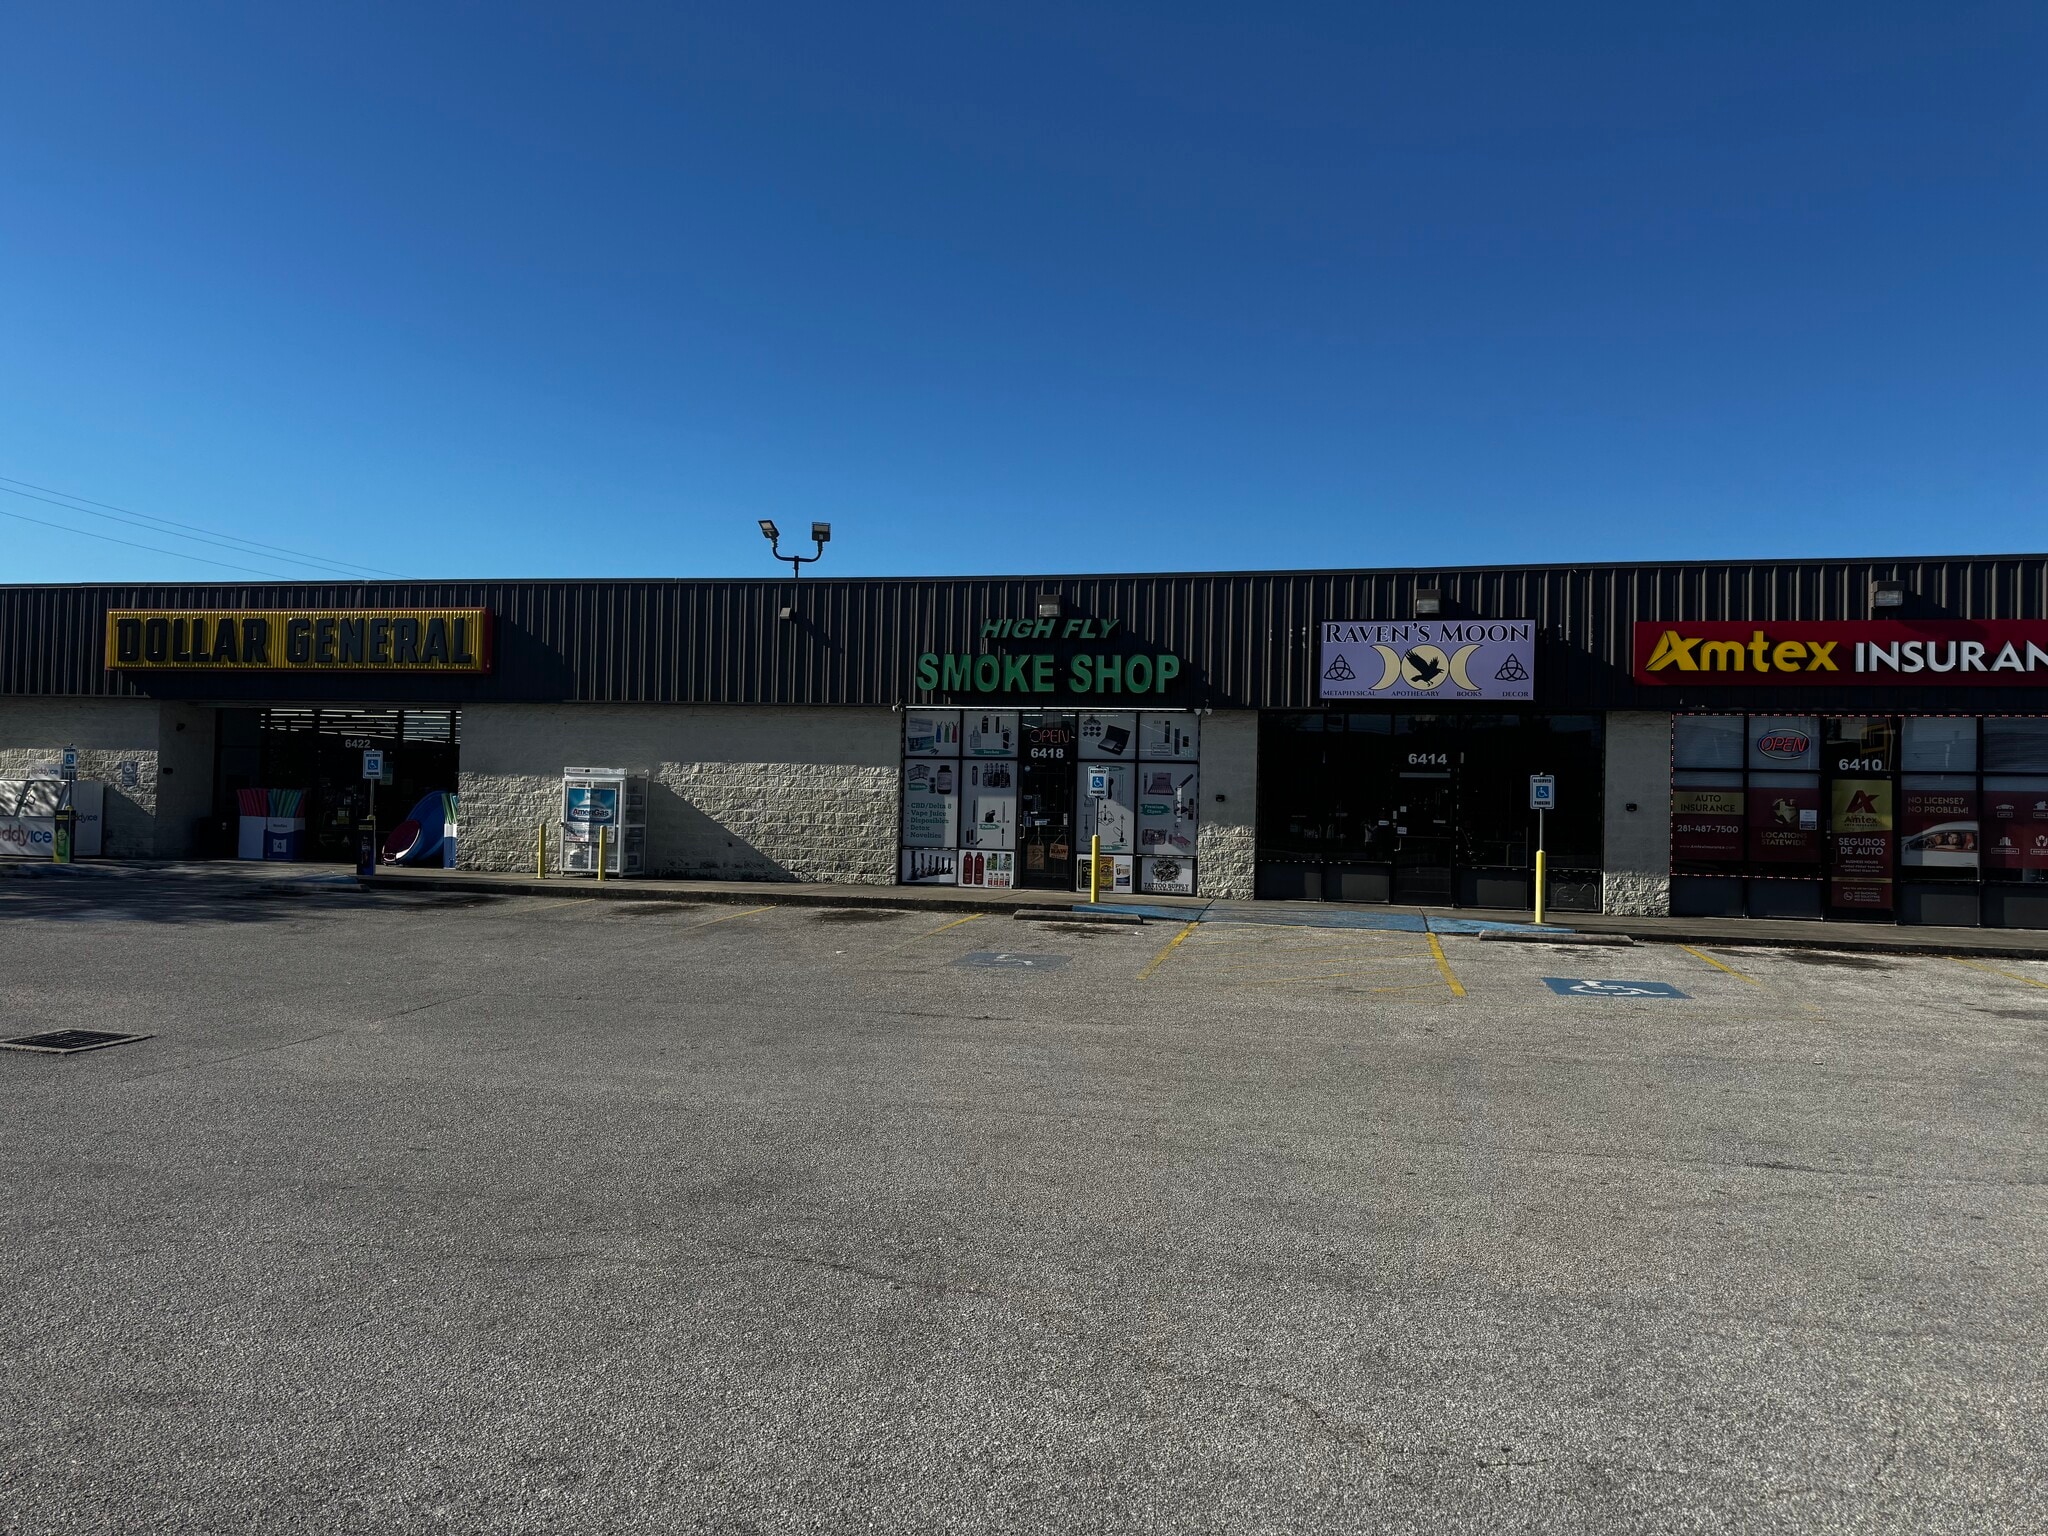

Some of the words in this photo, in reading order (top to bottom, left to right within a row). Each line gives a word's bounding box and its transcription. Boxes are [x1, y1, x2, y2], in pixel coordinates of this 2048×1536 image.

[980, 618, 1056, 639] HIGH
[1061, 618, 1120, 639] FLY
[1324, 622, 1431, 643] RAVEN'S
[1437, 623, 1530, 643] MOON
[117, 617, 268, 662] DOLLAR
[287, 617, 473, 663] GENERAL
[1645, 630, 1839, 673] Amtex
[1855, 640, 2048, 673] INSURAN
[916, 652, 1055, 692] SMOKE
[1068, 653, 1180, 694] SHOP
[1391, 690, 1440, 698] APOTHECARY
[1030, 729, 1070, 744] OPEN
[345, 738, 371, 749] 6422
[1761, 736, 1808, 752] OPEN
[1030, 747, 1064, 759] 6418
[1408, 753, 1448, 765] 6414
[1838, 758, 1883, 771] 6410
[1695, 794, 1721, 803] AUTO
[1907, 796, 1922, 804] NO
[1924, 796, 1965, 805] LICENSE?
[1680, 803, 1735, 813] INSURANCE
[1907, 805, 1922, 813] NO
[1924, 806, 1969, 814] PROBLEM!
[910, 809, 928, 818] Vape
[929, 809, 947, 818] Juice
[1844, 815, 1878, 824] Amtex
[1676, 824, 1739, 833] 281-487-7500
[910, 831, 942, 839] Novelties
[1838, 837, 1886, 846] SEGUROS
[1840, 846, 1853, 855] DE
[1856, 847, 1884, 856] AUTO
